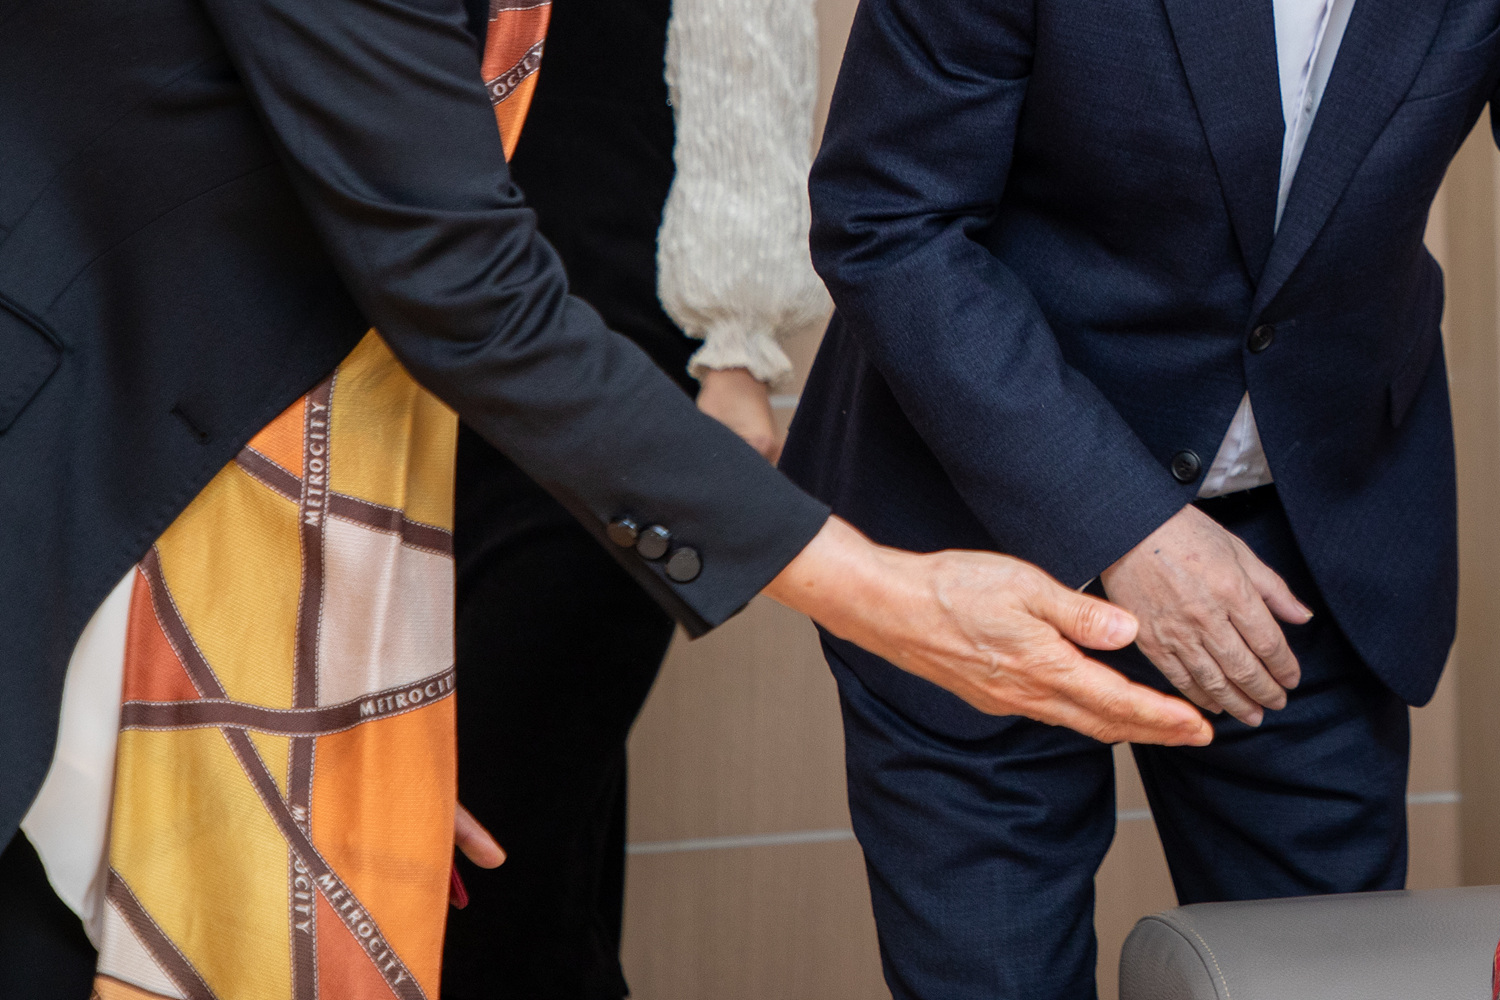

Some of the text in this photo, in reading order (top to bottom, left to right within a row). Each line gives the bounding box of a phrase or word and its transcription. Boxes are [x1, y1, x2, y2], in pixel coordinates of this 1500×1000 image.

[304, 401, 327, 527] METROCITY
[360, 672, 456, 717] METROCIT
[318, 873, 406, 986] METROCITY
